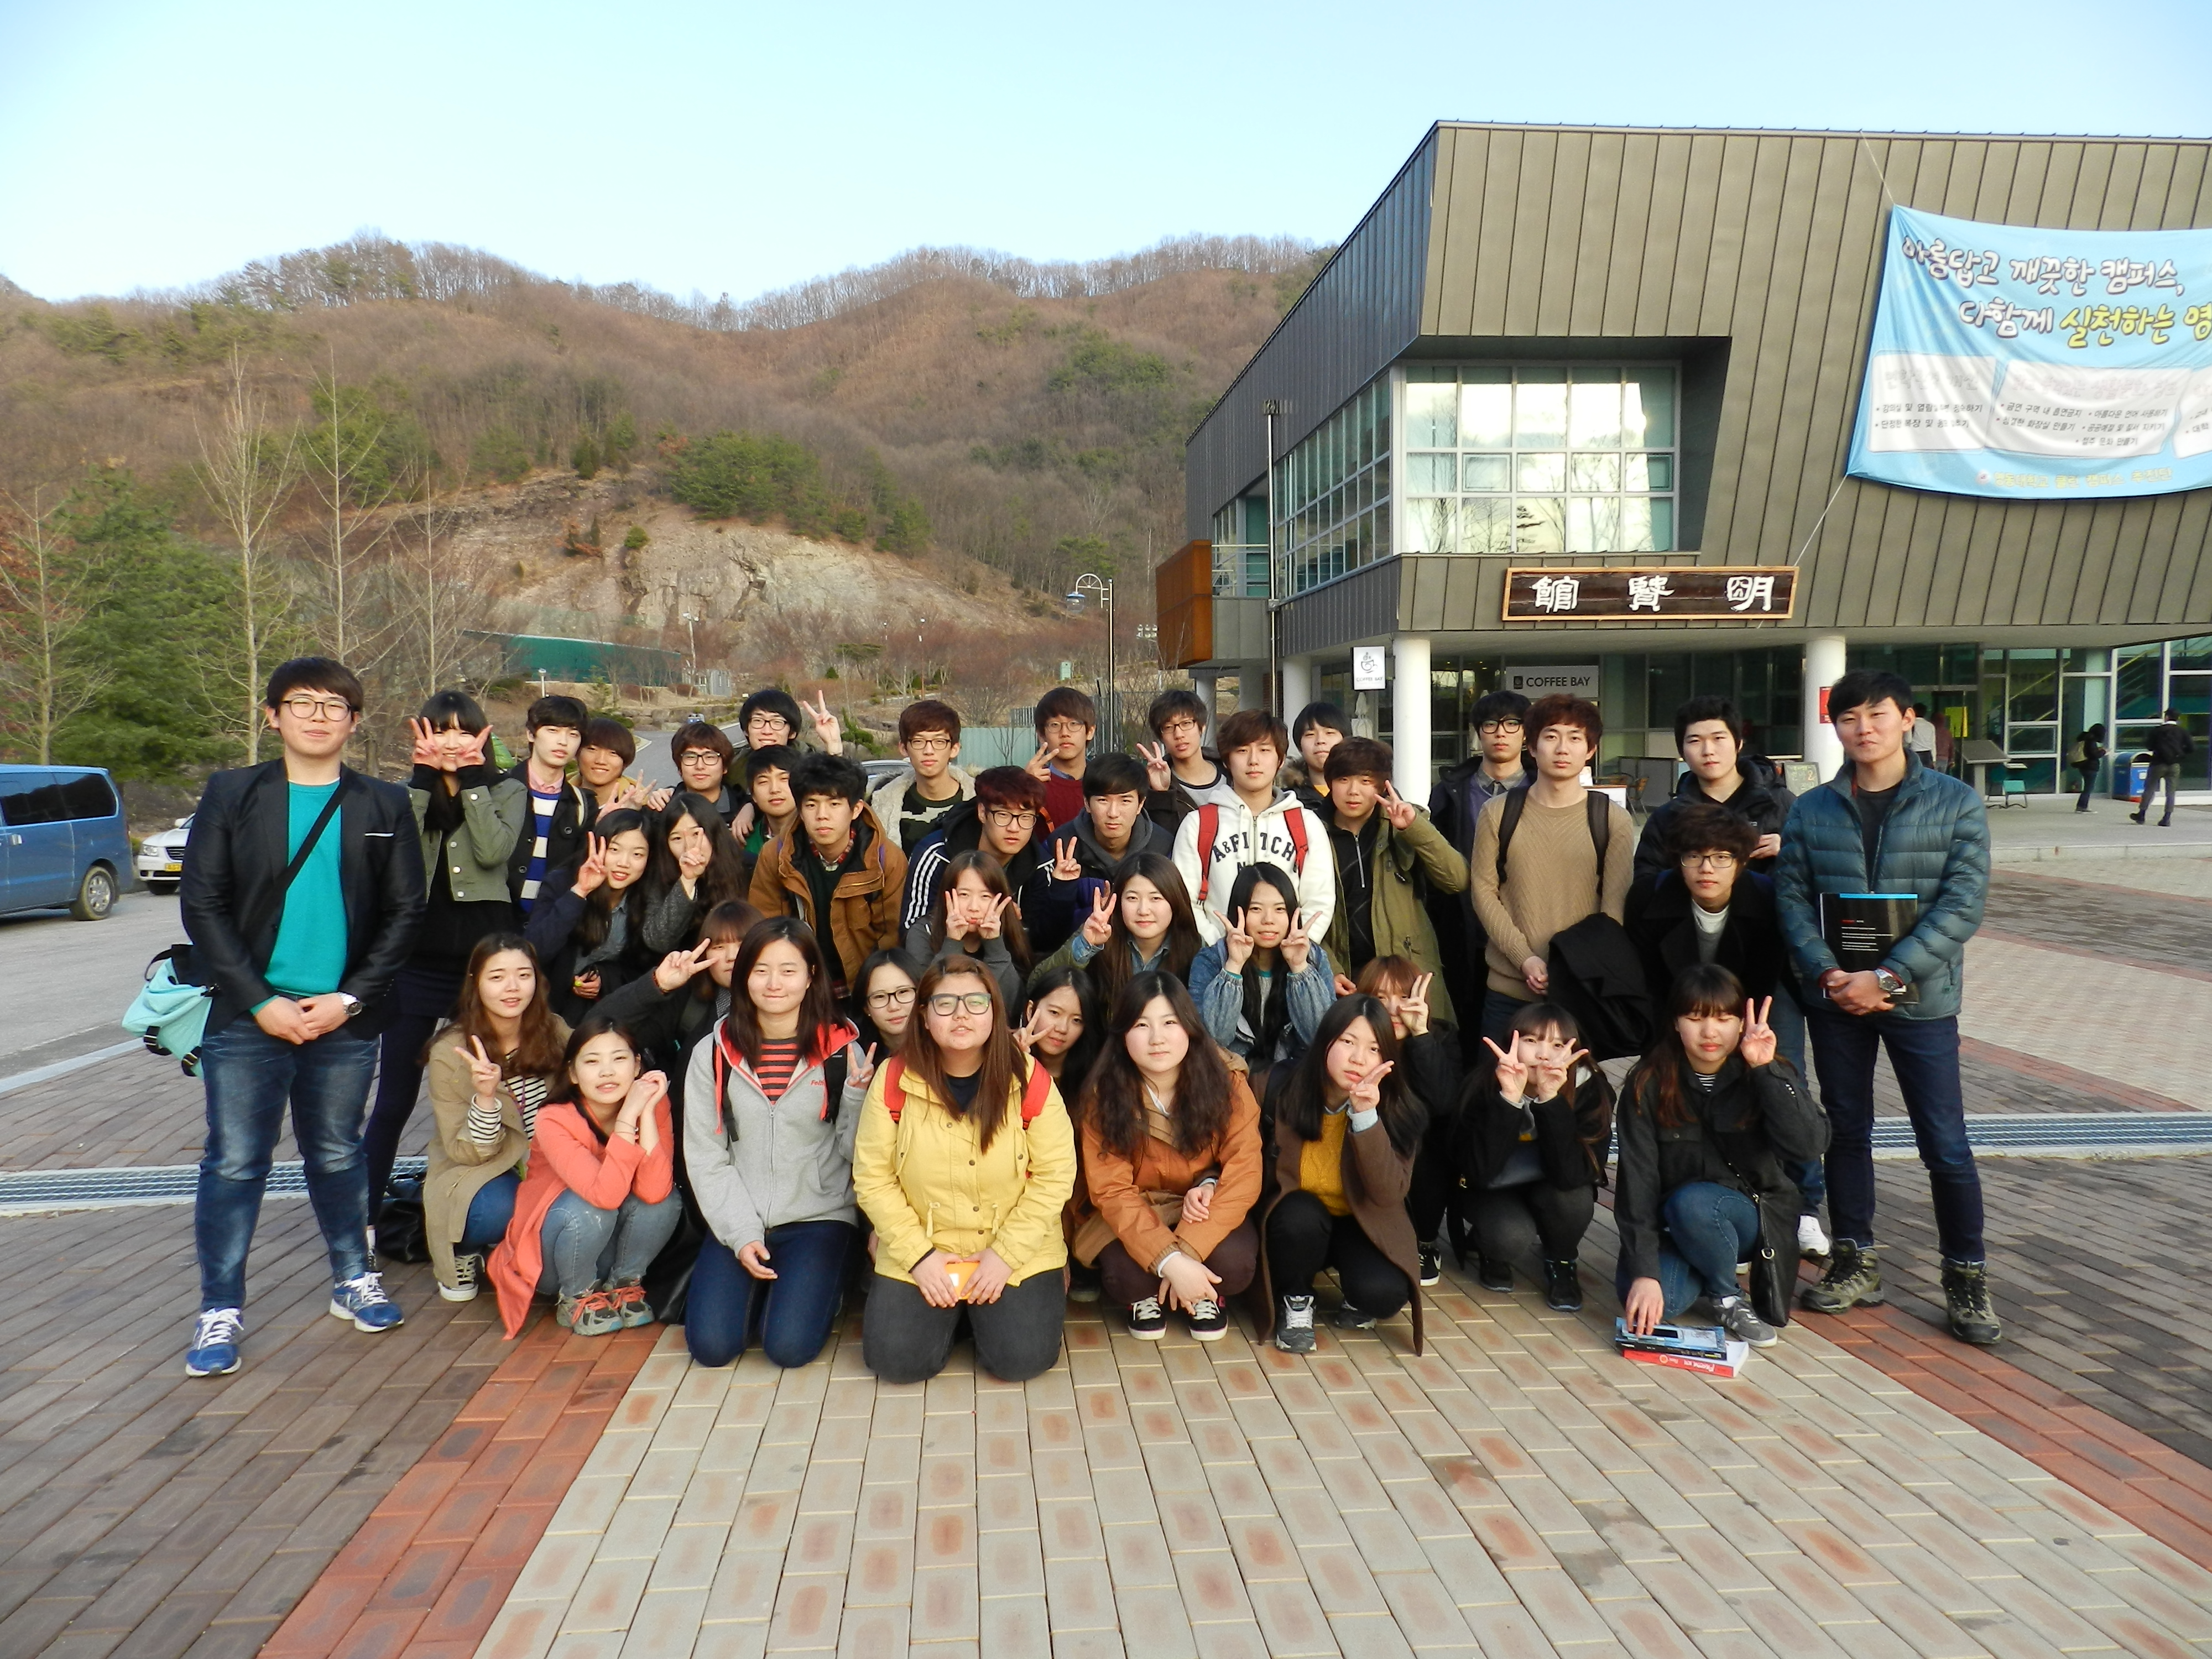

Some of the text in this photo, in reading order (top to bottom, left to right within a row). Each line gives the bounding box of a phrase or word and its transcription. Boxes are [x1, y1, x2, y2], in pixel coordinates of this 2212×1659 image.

[1902, 235, 2185, 297] 아름답고 깨끗한 캠퍼스,
[1959, 296, 2054, 338] 다함께
[2059, 303, 2176, 348] 실천하는
[1905, 403, 1912, 412] 및
[2006, 402, 2082, 418] 금연 구역 내 흡연금지
[2094, 408, 2168, 419] 아름다운 언어 사용하기
[1925, 419, 1933, 428] 및
[2027, 419, 2051, 430] 화장실
[2053, 422, 2077, 431] 만들기
[2087, 423, 2115, 432] 공공예절
[2142, 422, 2166, 431] 지키기
[2117, 437, 2138, 446] 만들기
[1995, 467, 2172, 488] 영동대학교 클린 캠퍼스 추진단
[1526, 676, 1590, 687] COFFEE BAY
